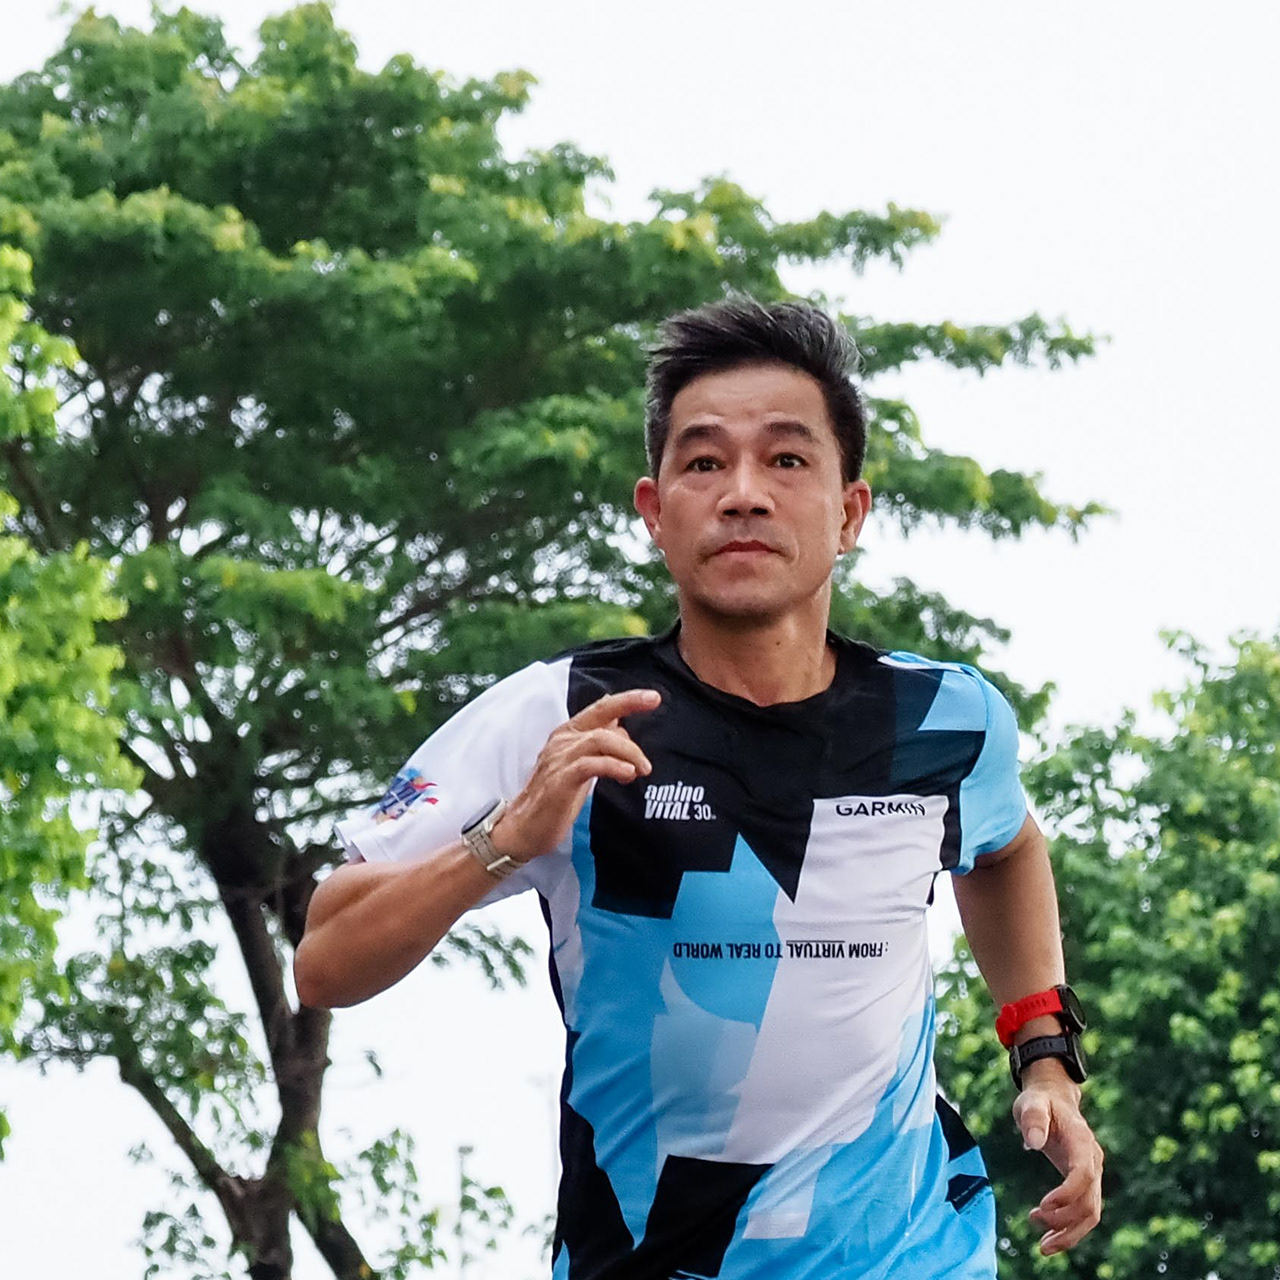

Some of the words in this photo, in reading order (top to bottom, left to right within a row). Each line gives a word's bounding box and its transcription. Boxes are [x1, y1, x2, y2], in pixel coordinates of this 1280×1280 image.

[644, 780, 705, 803] amino
[644, 799, 691, 820] VITAL
[835, 801, 926, 817] GARMIN
[673, 942, 723, 958] WORLD
[726, 943, 760, 958] REAL
[765, 942, 783, 958] TO
[786, 940, 845, 959] VIRTUAL
